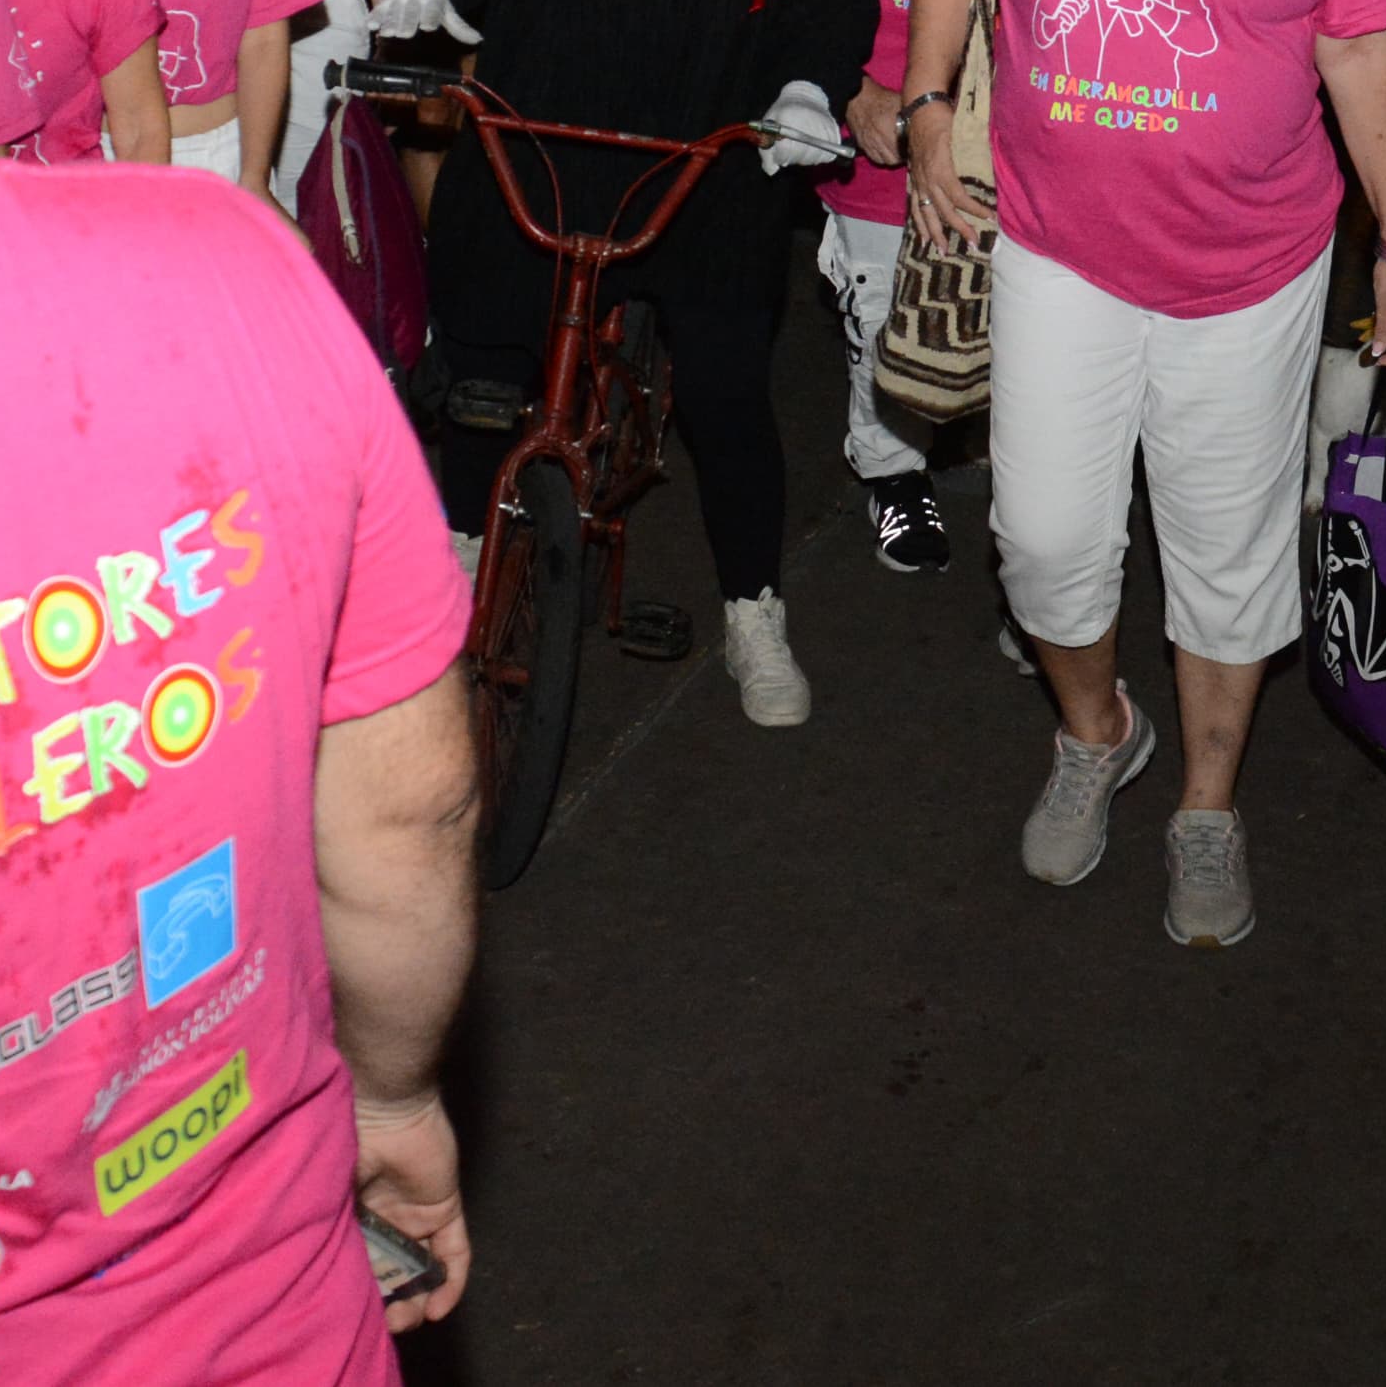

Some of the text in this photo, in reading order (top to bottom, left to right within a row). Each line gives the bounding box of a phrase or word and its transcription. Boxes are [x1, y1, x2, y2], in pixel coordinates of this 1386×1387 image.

[1029, 67, 1049, 91] EN
[1050, 102, 1179, 133] ME QUEDO
[103, 1056, 247, 1194] woopi
